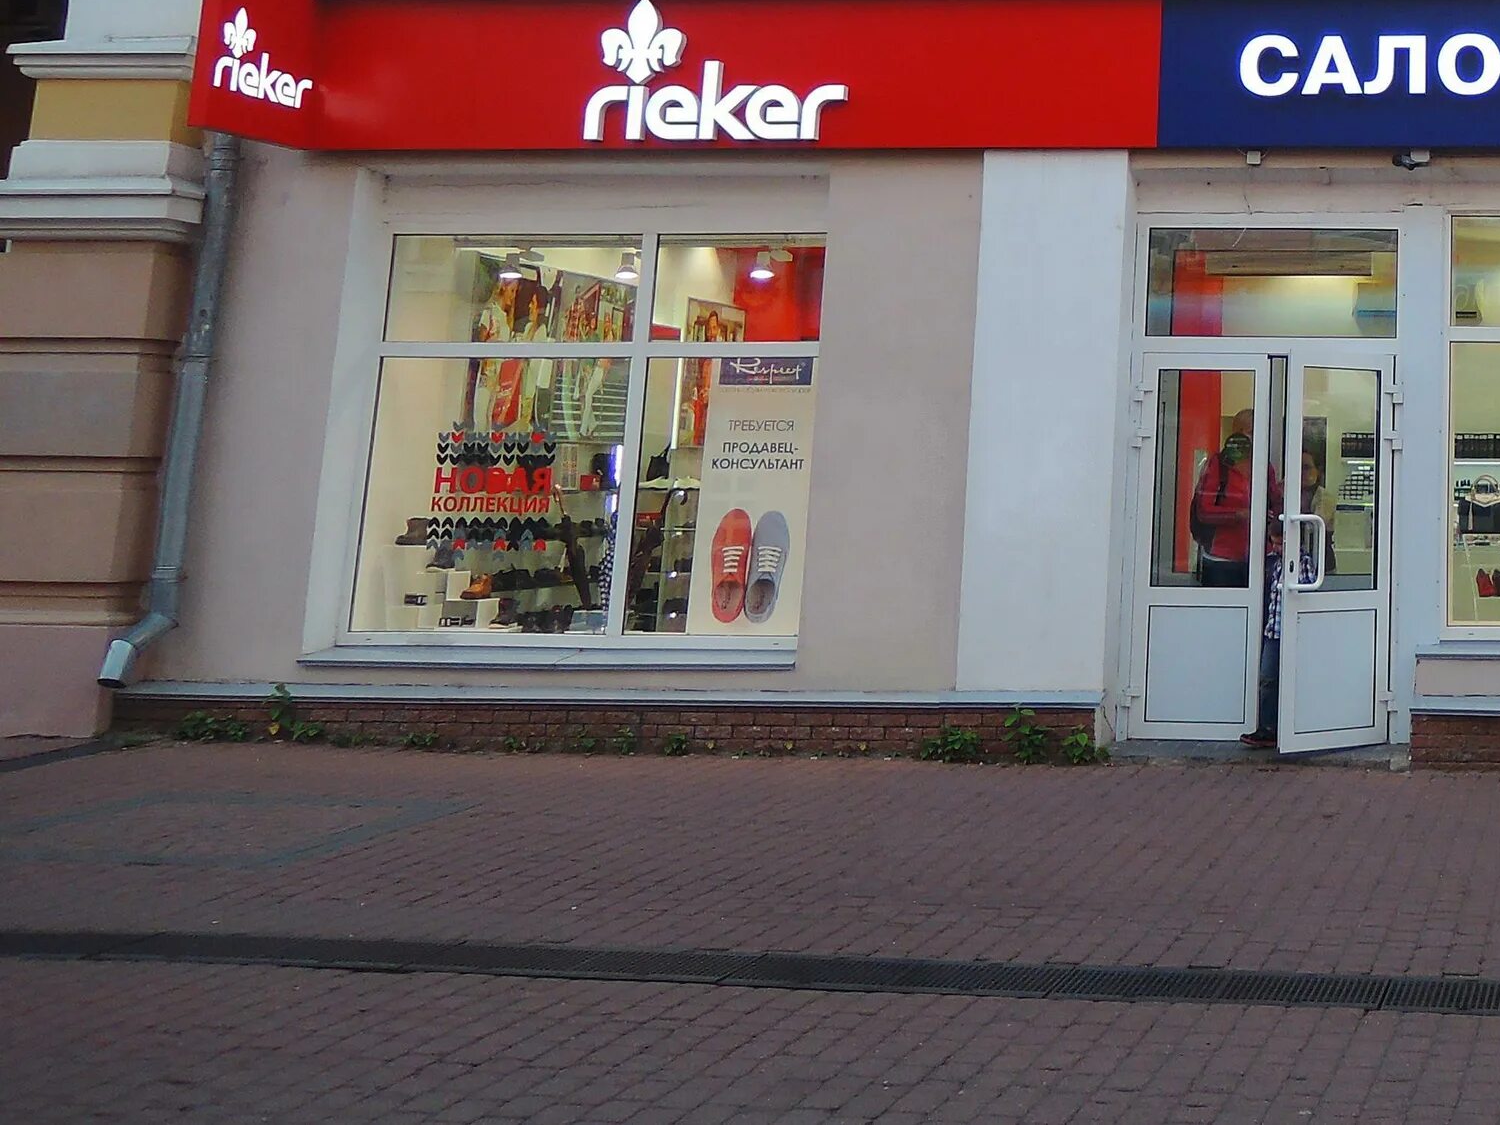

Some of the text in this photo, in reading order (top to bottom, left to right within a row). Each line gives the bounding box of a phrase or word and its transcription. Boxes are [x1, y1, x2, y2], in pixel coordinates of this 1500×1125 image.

[212, 52, 312, 110] rieker
[582, 59, 849, 142] rieker
[728, 418, 795, 433] ТРЕБУЕТСЯ
[721, 441, 800, 457] ПРОДАВЕЦ-
[711, 458, 805, 471] КОНСУЛЬТАНТ
[433, 466, 553, 495] НОВАЯ
[430, 495, 551, 516] КОЛЛЕКЦИЯ
